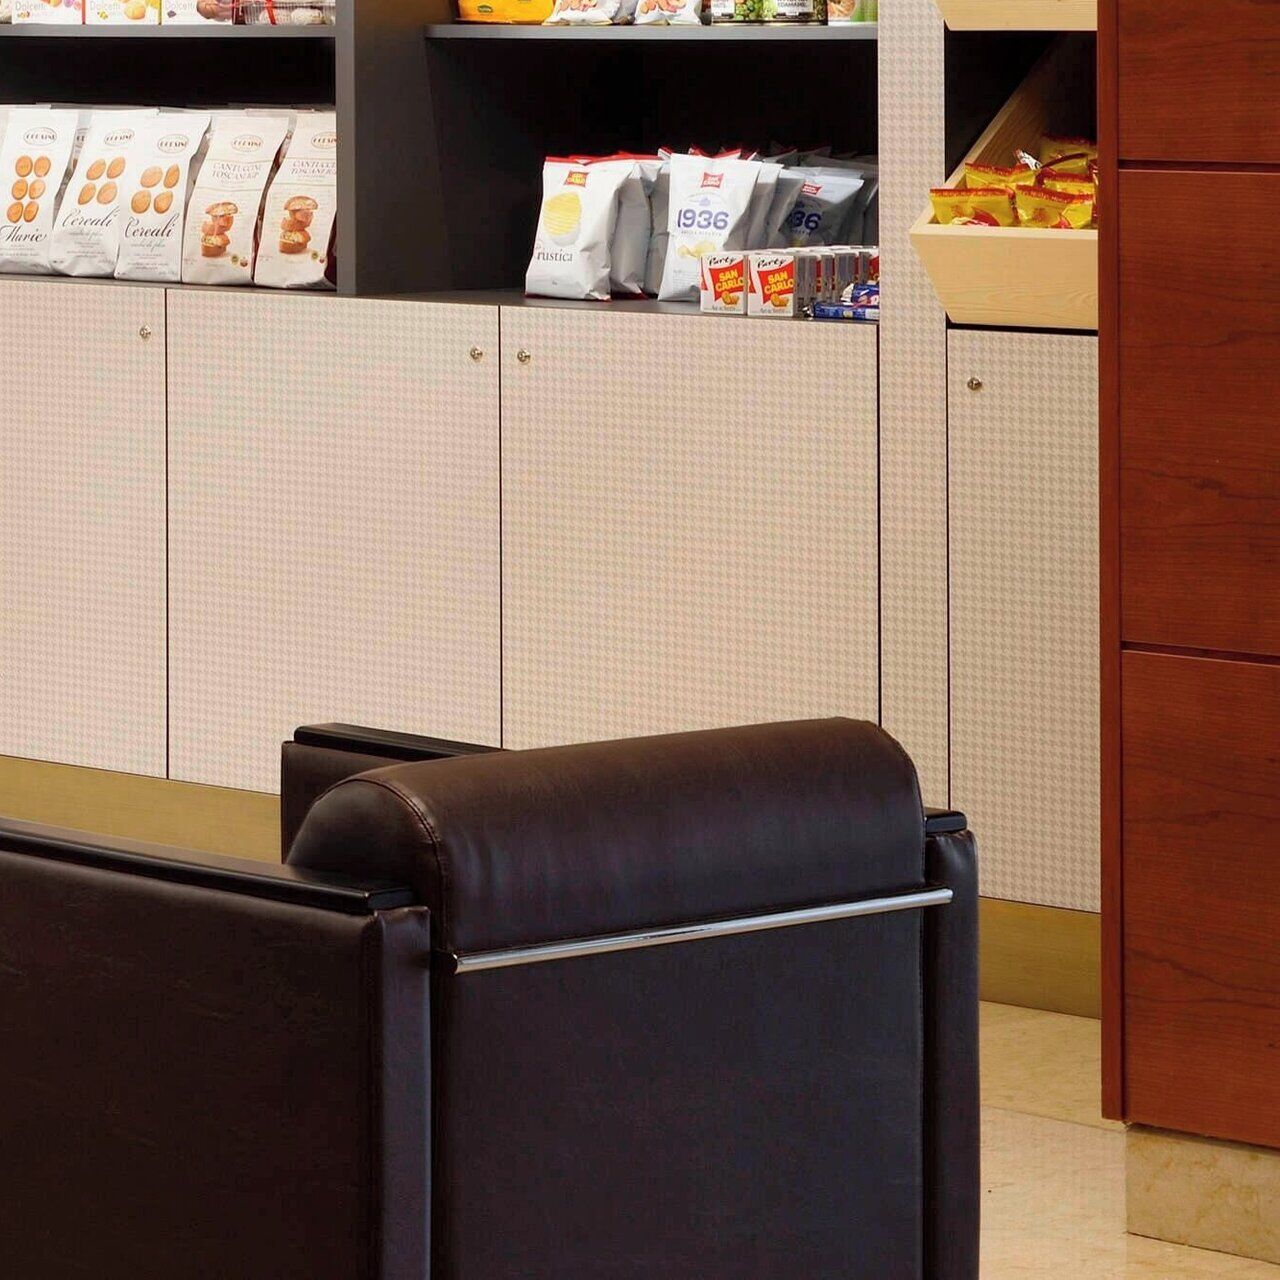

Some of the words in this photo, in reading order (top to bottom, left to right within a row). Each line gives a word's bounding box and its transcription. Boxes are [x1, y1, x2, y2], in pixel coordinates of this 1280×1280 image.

[125, 212, 180, 238] Cereali
[677, 209, 729, 230] 1936
[792, 210, 822, 231] 36
[709, 256, 736, 267] Party
[757, 257, 786, 269] Party
[719, 269, 738, 282] SAN
[767, 271, 788, 283] SAN
[715, 278, 744, 292] CARLO
[764, 278, 794, 295] CARLO
